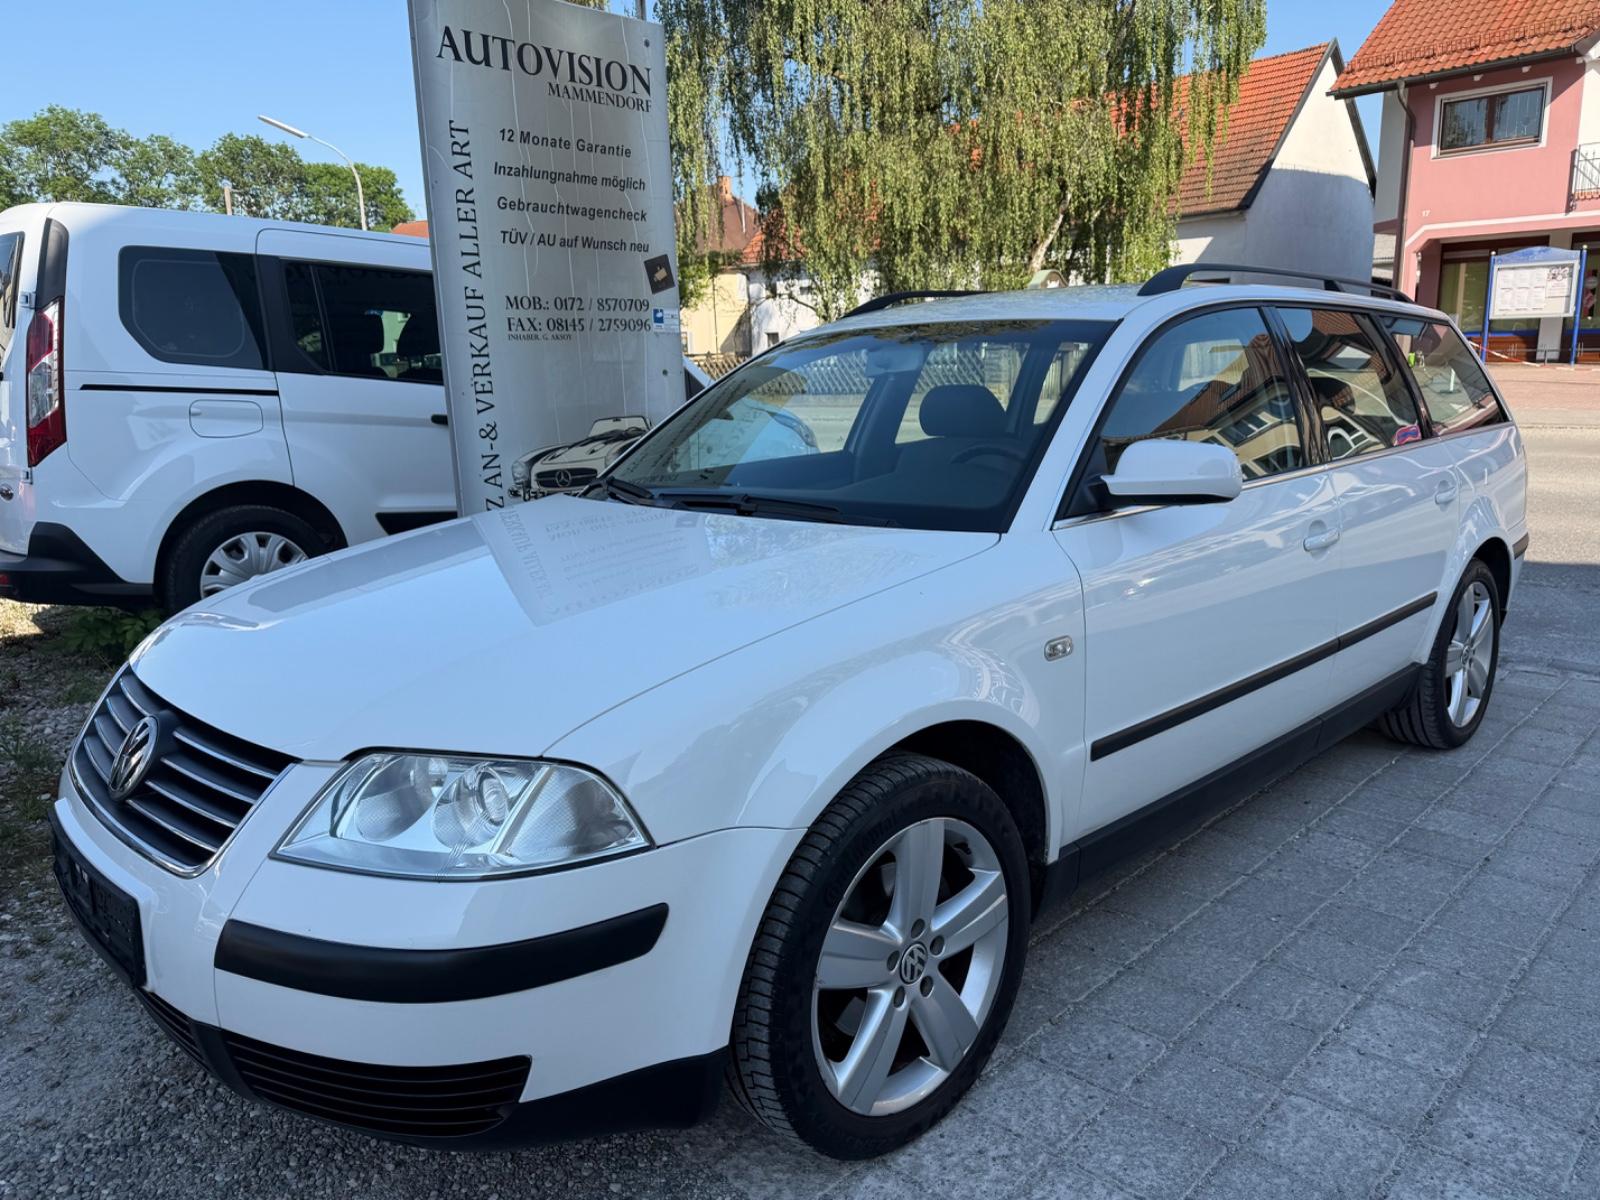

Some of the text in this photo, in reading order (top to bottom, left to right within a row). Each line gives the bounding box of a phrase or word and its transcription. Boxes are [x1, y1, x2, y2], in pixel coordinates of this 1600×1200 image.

[436, 25, 651, 97] AUTOVISION
[547, 82, 652, 113] MAMMENDORF
[449, 119, 473, 180] ART
[499, 128, 632, 158] 12 Monate Garantie
[493, 161, 646, 195] Inzahlungnahme möglich
[497, 196, 648, 222] Gebrauchtwagencheck
[455, 187, 482, 278] ALLER
[559, 235, 578, 249] auf
[581, 237, 627, 252] Wunsch
[629, 242, 649, 253] neu
[505, 295, 550, 311] MOB.:
[554, 296, 584, 312] 0172
[596, 297, 650, 312] 8570709
[506, 316, 542, 332] FAX:
[546, 317, 585, 332] 08145
